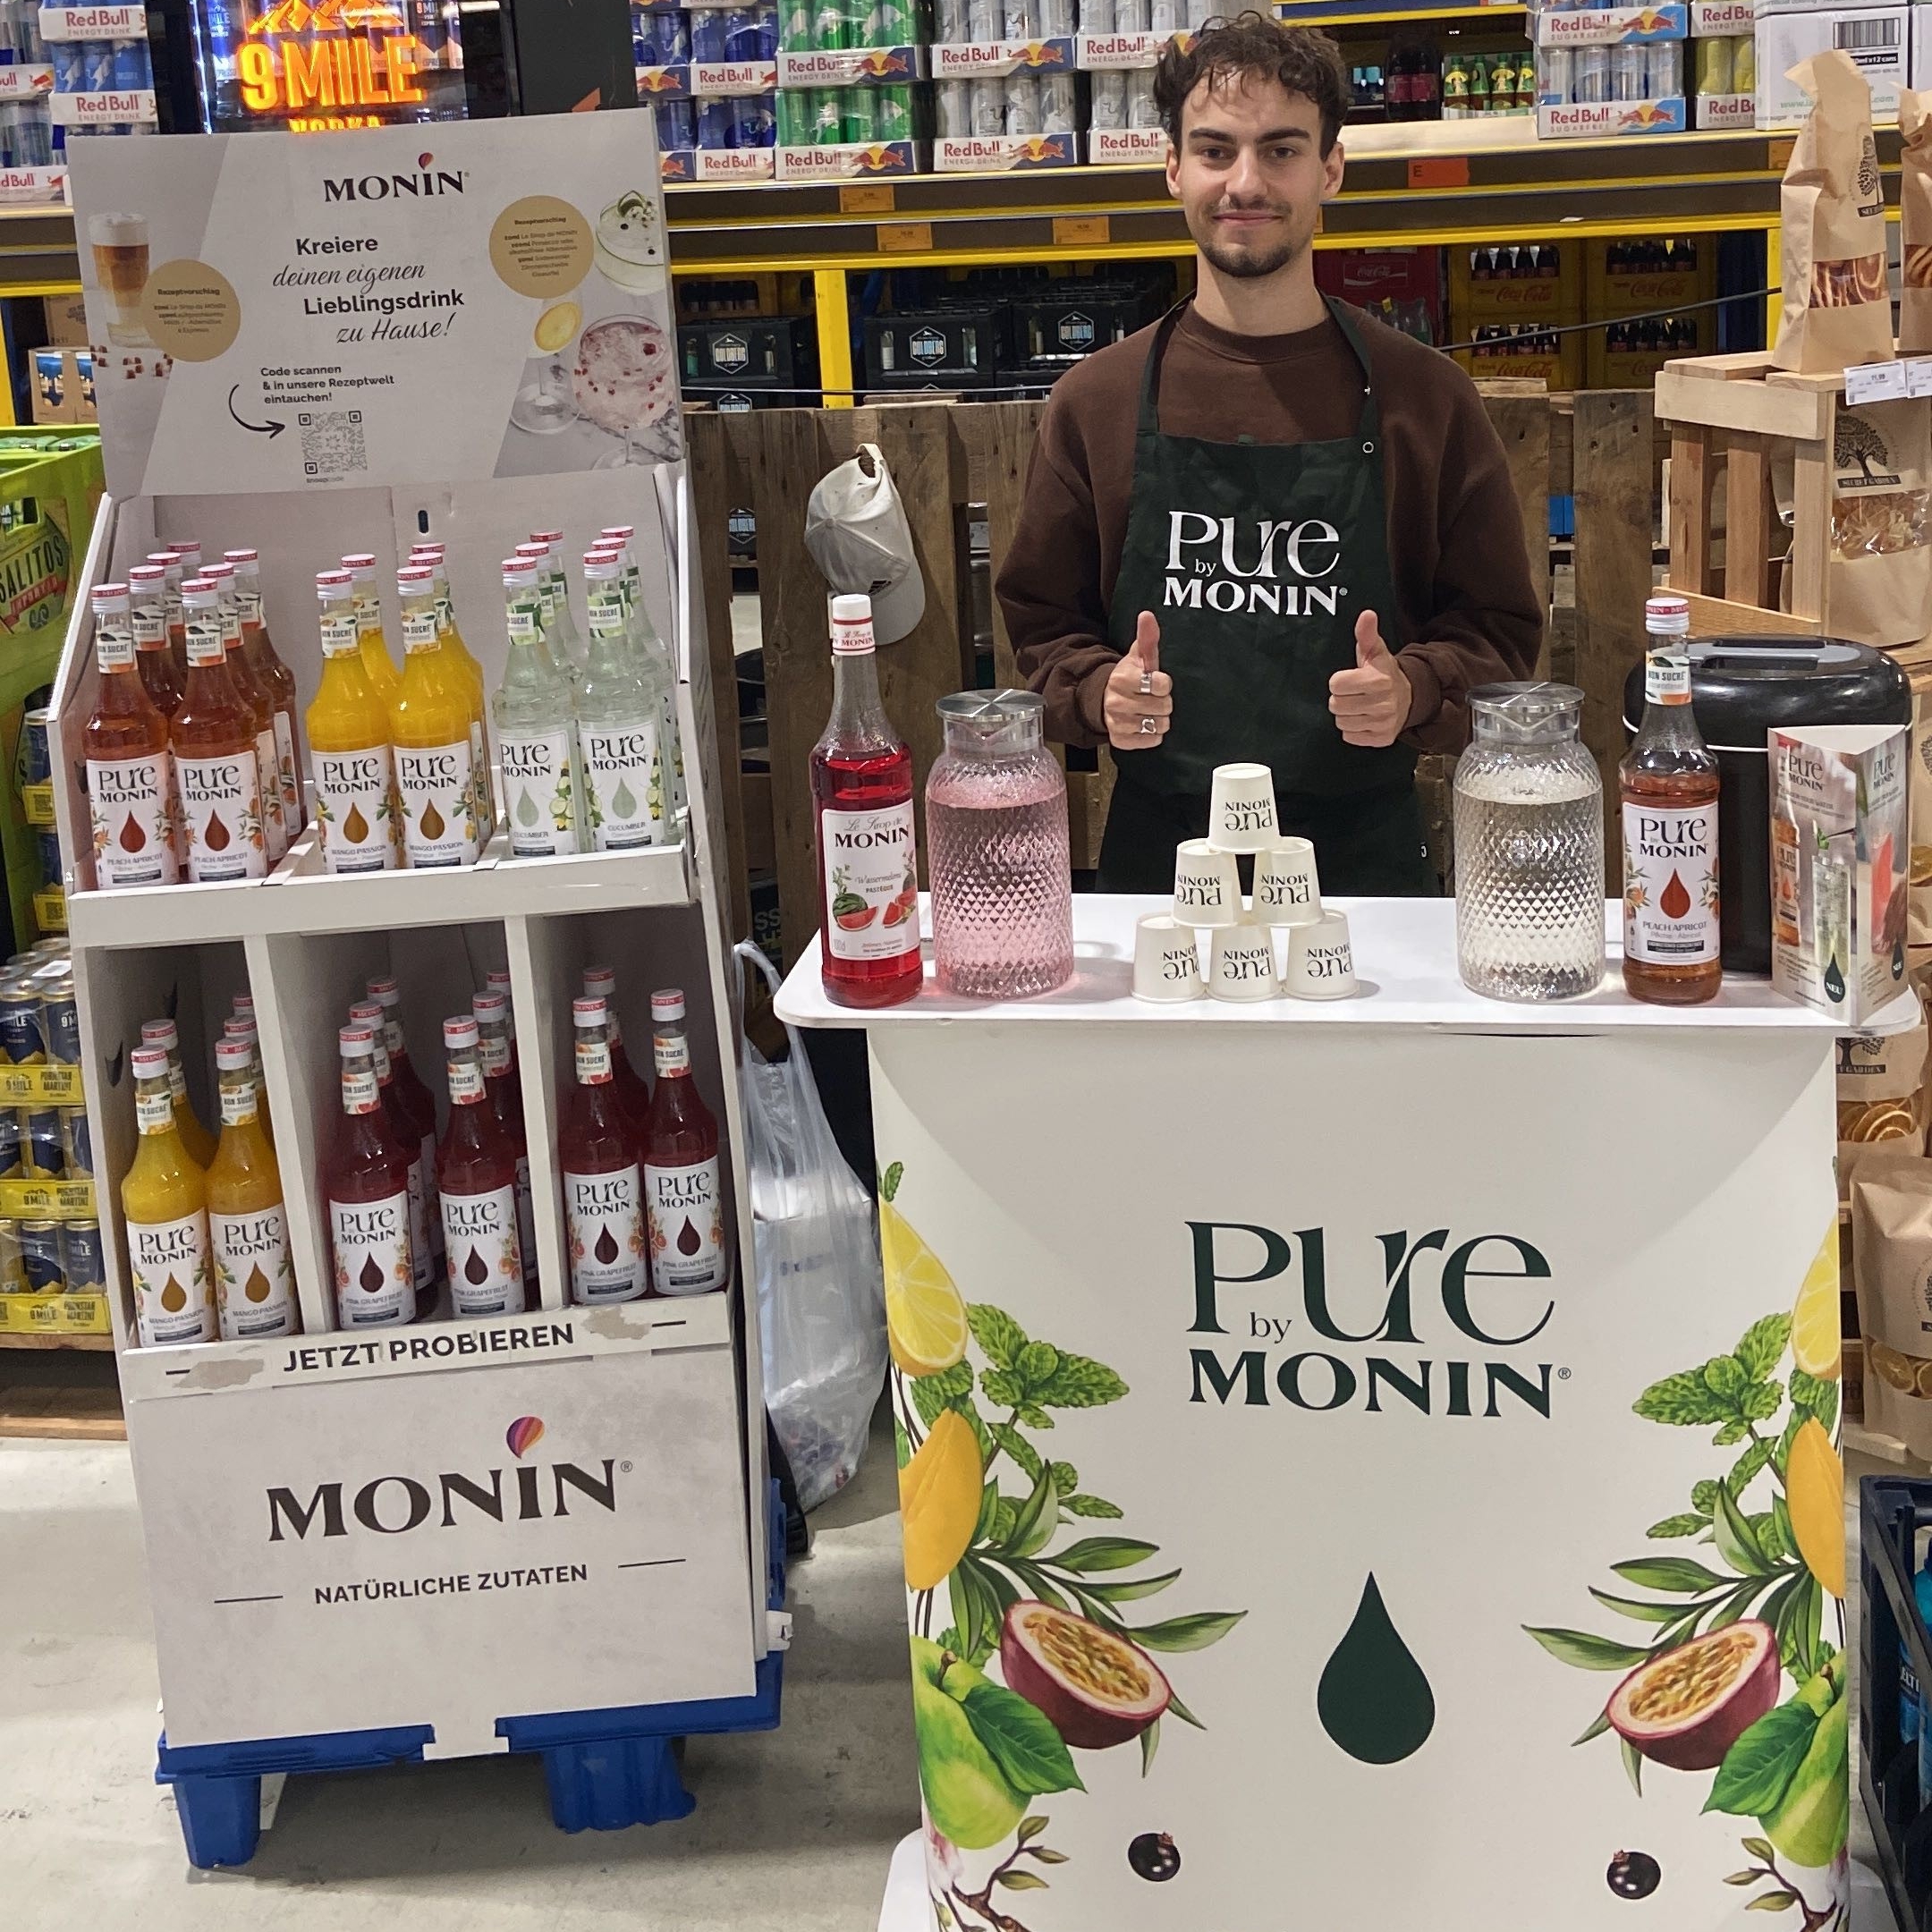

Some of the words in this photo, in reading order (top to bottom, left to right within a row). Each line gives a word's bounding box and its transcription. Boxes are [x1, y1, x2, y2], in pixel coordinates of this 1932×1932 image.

[66, 11, 97, 27] Red
[100, 8, 130, 25] Bull
[1702, 8, 1732, 21] Red
[1734, 6, 1753, 20] Bu
[1551, 17, 1580, 32] Red
[943, 48, 970, 64] Red
[972, 46, 999, 62] Bull
[1087, 39, 1115, 54] Red
[1118, 37, 1146, 53] Bull
[240, 42, 277, 110] 9
[281, 35, 423, 108] MILE
[787, 58, 815, 72] Red
[699, 70, 724, 83] Red
[727, 67, 752, 81] Bull
[77, 96, 107, 113] Red
[110, 94, 140, 111] Bull
[1709, 100, 1738, 114] Red
[1551, 109, 1580, 124] Red
[1582, 107, 1609, 123] Bull
[945, 142, 971, 157] Red
[973, 140, 1000, 156] Bull
[1100, 134, 1128, 149] Red
[1131, 132, 1158, 148] Bull
[705, 155, 729, 169] Red
[732, 153, 757, 167] Bull
[785, 153, 812, 167] Red
[816, 151, 842, 165] Bull
[11, 173, 35, 187] Bull
[323, 171, 465, 202] MONIN
[296, 236, 378, 256] Kreiere
[272, 264, 342, 287] deinen
[346, 264, 427, 294] eigenen
[303, 289, 465, 315] Lieblingsdrink
[335, 327, 366, 343] zu
[370, 312, 457, 341] Hause!
[260, 367, 291, 377] Code
[293, 366, 342, 376] scannen
[274, 380, 284, 390] in
[286, 380, 326, 390] unsere
[328, 375, 395, 388] Rezeptwelt
[264, 392, 333, 403] eintauchen!
[1165, 511, 1340, 578] Pure
[1195, 558, 1217, 577] by
[1163, 576, 1338, 616] MONIN
[500, 743, 551, 766] Pure
[590, 733, 646, 758] Pure
[323, 758, 379, 783] Pure
[402, 755, 457, 778] Pure
[501, 765, 552, 777] MONIN
[592, 756, 647, 771] MONIN
[99, 766, 157, 792] Pure
[184, 765, 241, 791] Pure
[324, 779, 381, 794] MONIN
[402, 776, 458, 791] MONIN
[99, 786, 158, 803] MONIN
[186, 785, 243, 801] MONIN
[1224, 798, 1271, 812] MONIN
[1224, 809, 1274, 832] Pure
[835, 824, 911, 849] MONIN
[1640, 817, 1707, 845] Pure
[1640, 843, 1707, 859] MONIN
[1177, 874, 1221, 887] MONIN
[1261, 873, 1309, 886] MONIN
[1177, 886, 1223, 907] Pure
[1261, 884, 1310, 906] Pure
[1642, 921, 1671, 931] PEACH
[1673, 920, 1707, 932] APRICOT
[1224, 946, 1269, 961] MONIN
[1224, 957, 1272, 980] Pure
[576, 1179, 629, 1204] Pure
[657, 1171, 710, 1196] Pure
[577, 1199, 631, 1216] MONIN
[659, 1191, 712, 1208] MONIN
[340, 1208, 395, 1233] Pure
[446, 1201, 498, 1225] Pure
[139, 1225, 196, 1253] Pure
[224, 1216, 280, 1244] Pure
[341, 1228, 396, 1245] MONIN
[447, 1222, 501, 1237] MONIN
[140, 1245, 199, 1265] MONIN
[225, 1238, 282, 1257] MONIN
[1184, 1221, 1555, 1346] Pure
[1249, 1311, 1293, 1344] by
[283, 1342, 381, 1373] JETZT
[388, 1322, 575, 1362] PROBIEREN
[1189, 1348, 1555, 1420] MONIN
[267, 1459, 616, 1543] MONIN
[315, 1573, 472, 1606] NATÜRLICHE
[477, 1563, 589, 1596] ZUTATEN
